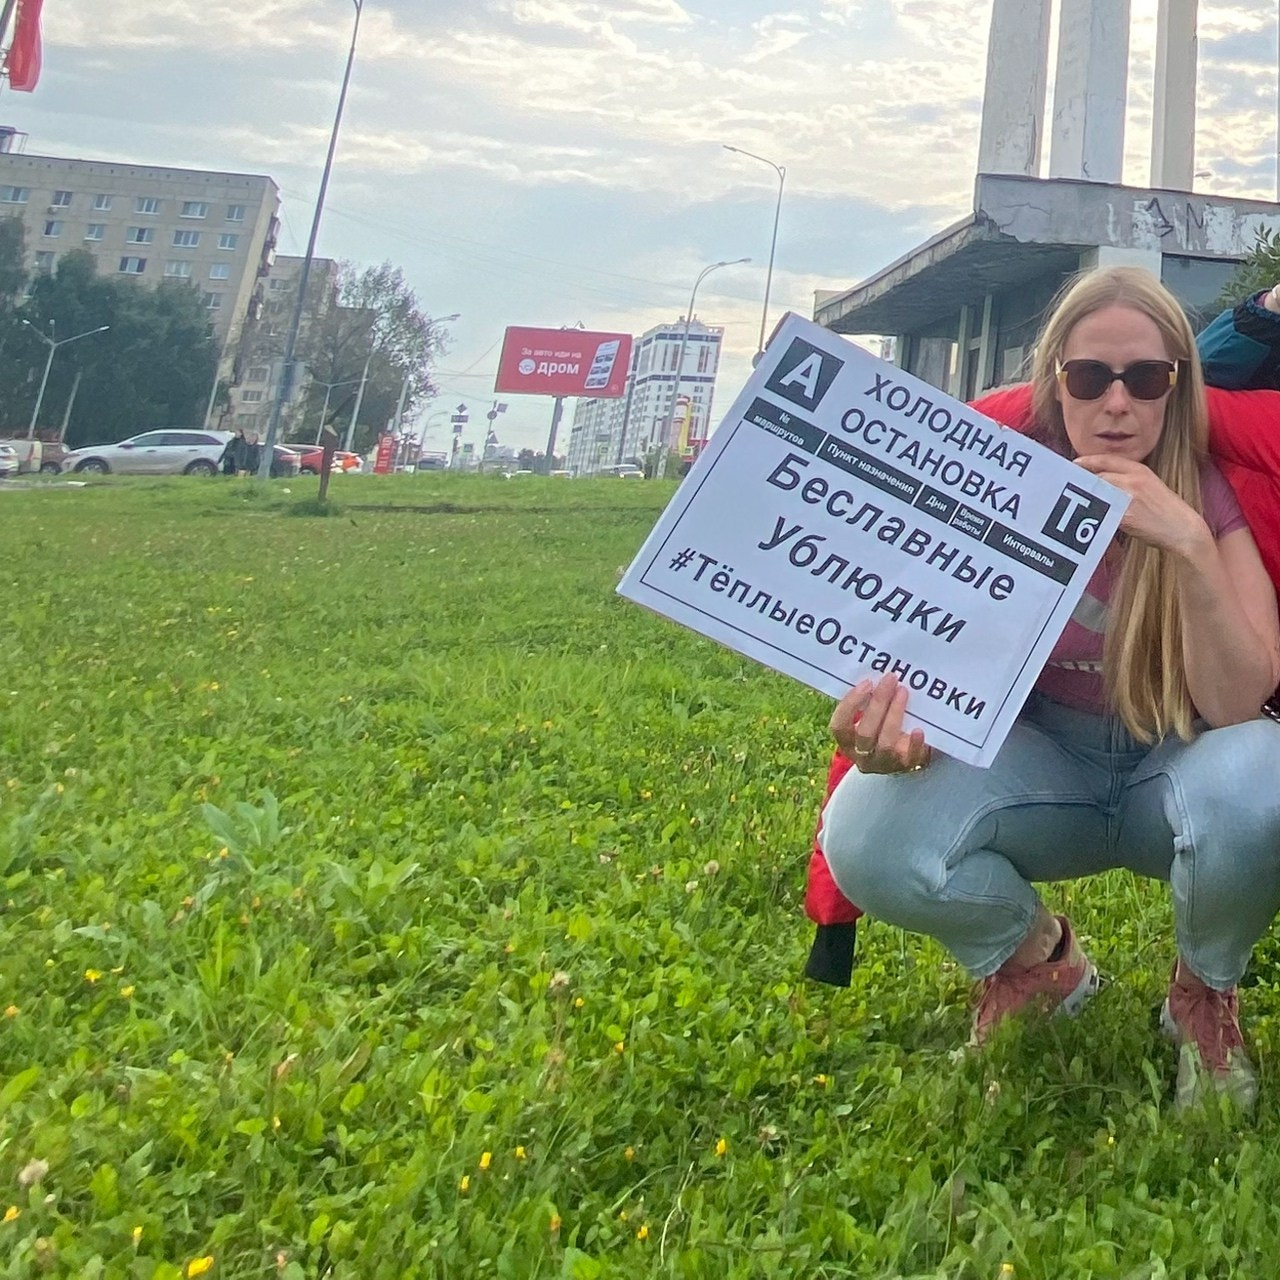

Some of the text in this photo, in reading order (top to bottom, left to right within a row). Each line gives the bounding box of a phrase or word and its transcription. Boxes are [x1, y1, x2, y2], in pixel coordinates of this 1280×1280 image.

[537, 362, 579, 376] дром
[779, 351, 825, 399] А
[753, 414, 805, 446] маршрутов
[779, 412, 791, 424] №
[863, 373, 1033, 478] ХОЛОДНАЯ
[827, 443, 916, 495] Пункт назначения
[841, 408, 1022, 520] ОСТАНОВКА
[925, 494, 948, 513] Дни
[960, 508, 986, 527] Время
[766, 453, 1016, 601] Беславные
[952, 517, 983, 537] работы
[1002, 534, 1056, 569] Интервалы
[758, 516, 968, 643] Ублюдки
[668, 546, 987, 721] #ТёплыеОстановки
